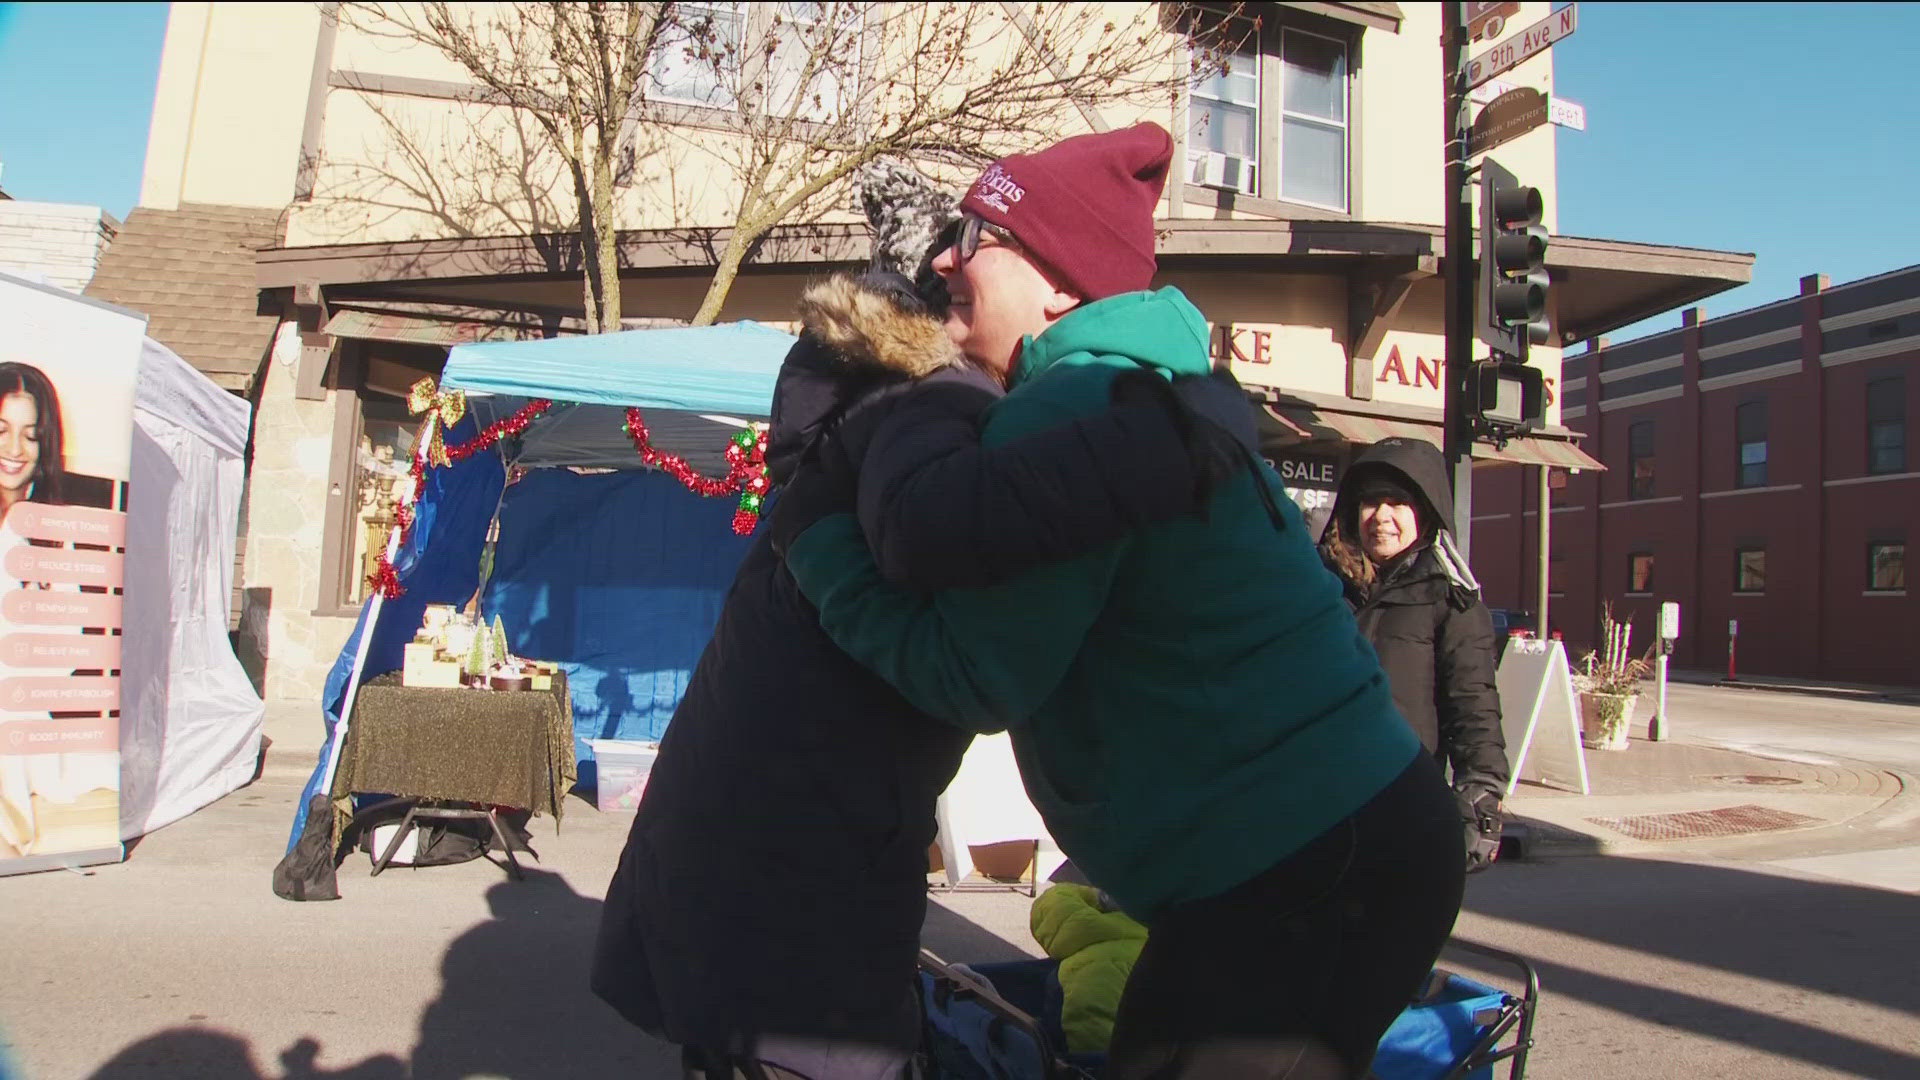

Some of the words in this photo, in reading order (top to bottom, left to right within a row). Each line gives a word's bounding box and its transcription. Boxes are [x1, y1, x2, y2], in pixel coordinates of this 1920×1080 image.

[1491, 45, 1514, 70] 9th
[1523, 25, 1550, 53] Ave
[1560, 9, 1571, 34] N
[1209, 326, 1271, 365] KE
[1281, 460, 1334, 482] SALE
[1303, 489, 1329, 508] SF
[38, 560, 72, 572] REDUCE
[28, 731, 58, 742] BOOST
